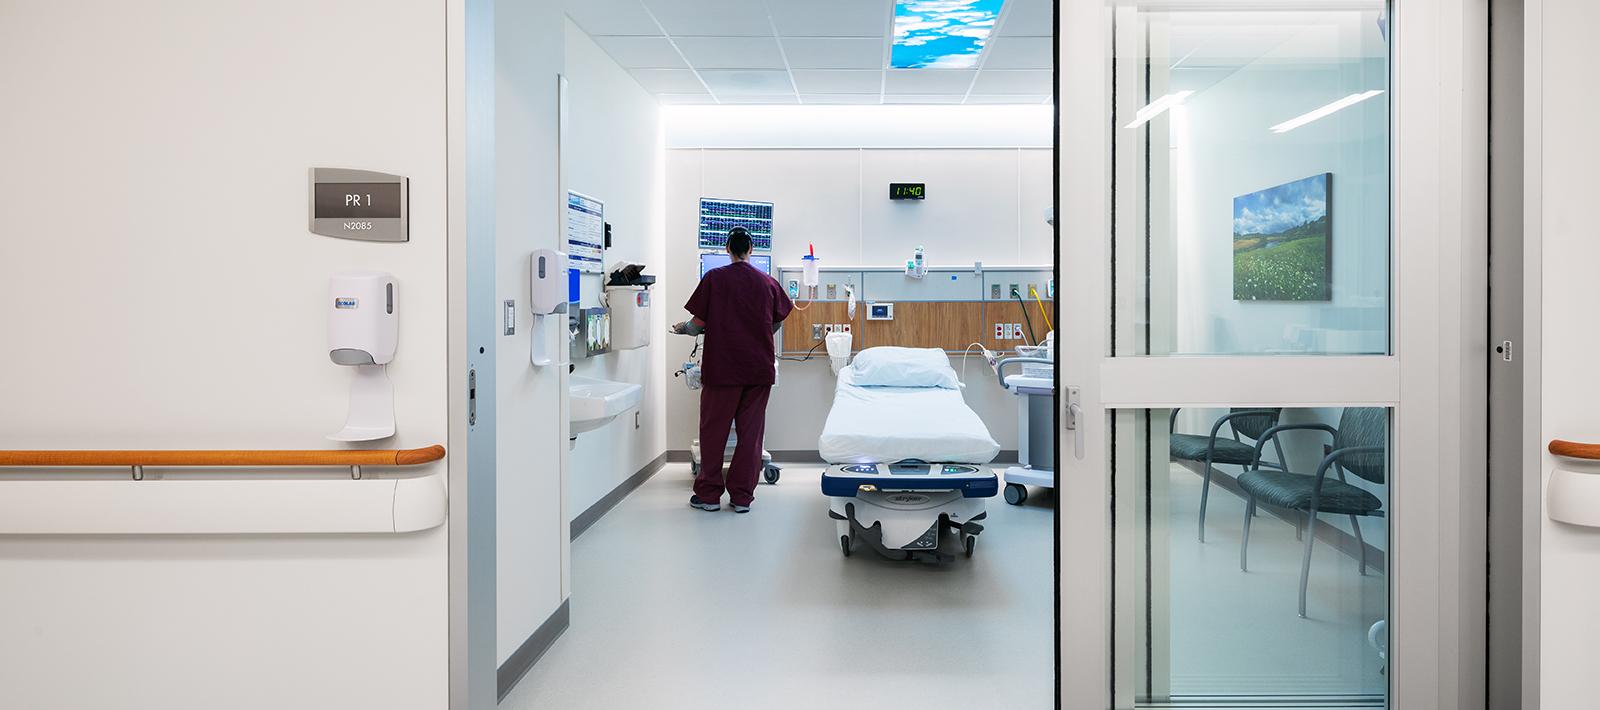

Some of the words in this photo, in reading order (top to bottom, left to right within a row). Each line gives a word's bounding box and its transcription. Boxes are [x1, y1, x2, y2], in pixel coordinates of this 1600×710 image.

[896, 187, 922, 196] 11:40
[345, 194, 361, 206] PR
[366, 194, 371, 206] 1
[343, 222, 372, 230] N2085
